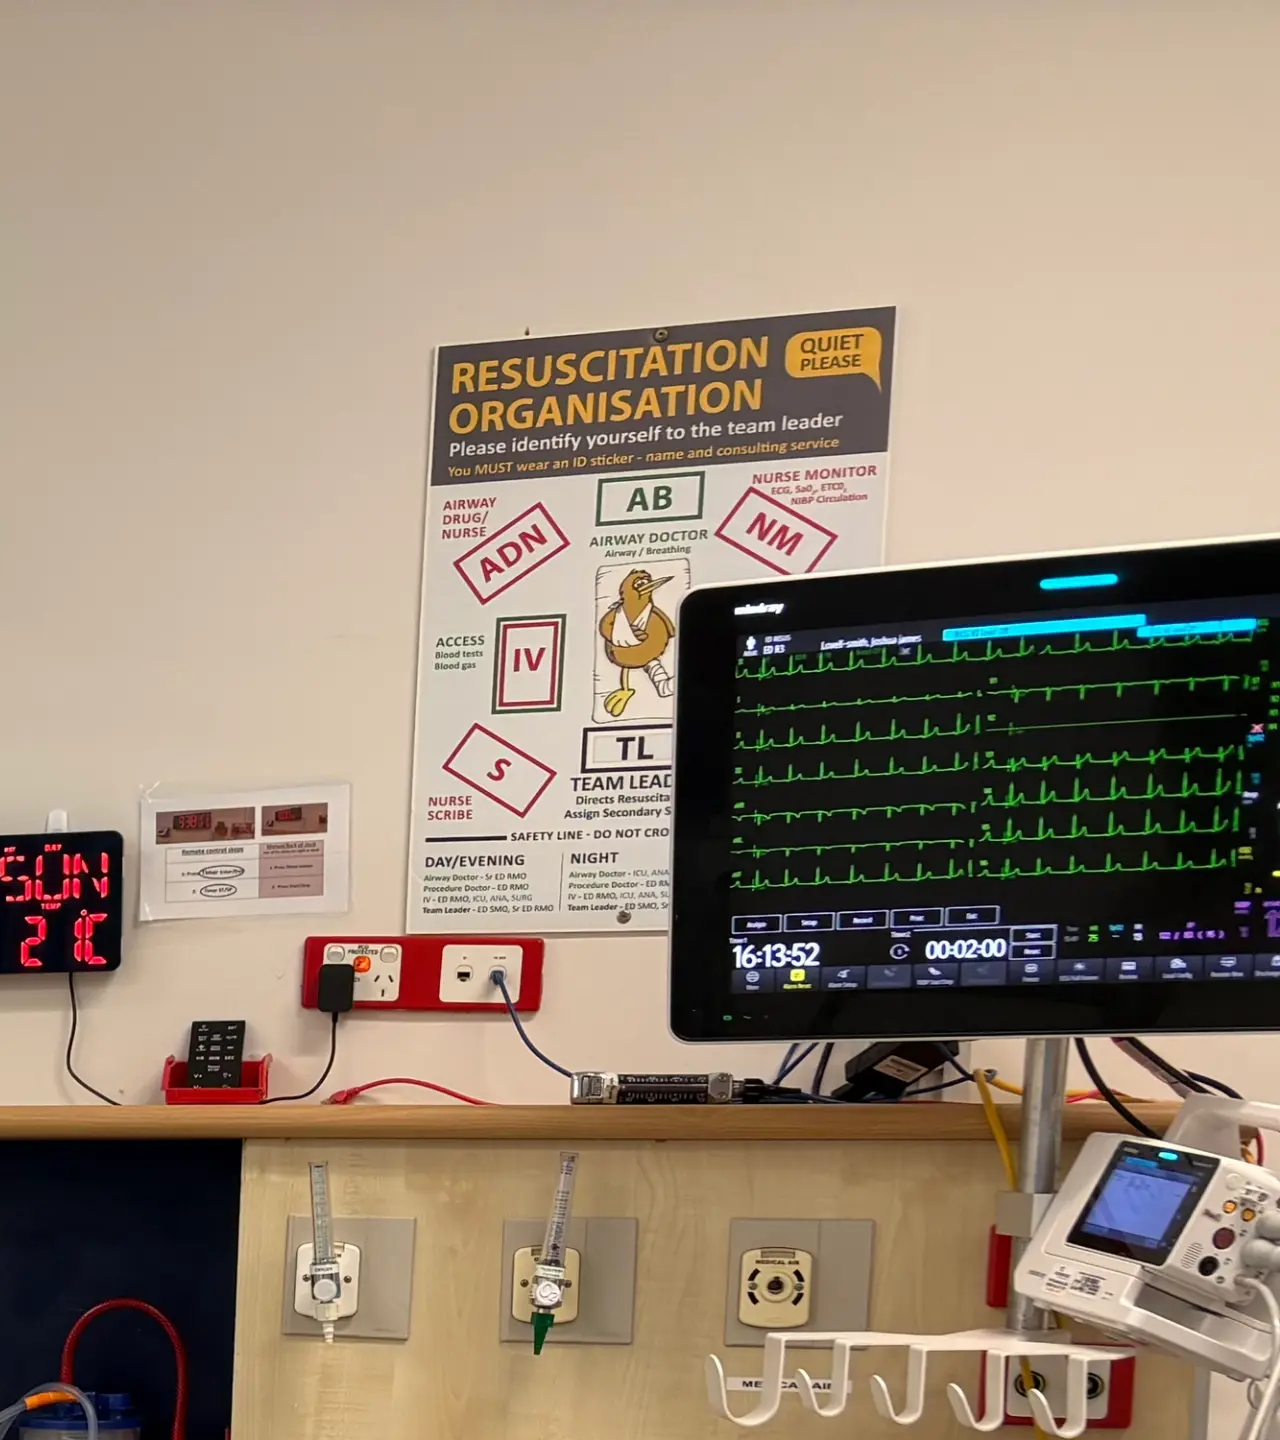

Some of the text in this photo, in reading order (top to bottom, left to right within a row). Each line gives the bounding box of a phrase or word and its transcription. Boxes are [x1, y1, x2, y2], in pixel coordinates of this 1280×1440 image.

[800, 333, 865, 355] QUIET
[451, 336, 769, 395] RESUSCITATION
[800, 354, 862, 372] PLEASE
[448, 378, 763, 435] ORGANISATION
[449, 412, 844, 458] Please identify yourself to the team leader
[448, 436, 840, 478] You MUST wear an ID sticker name and consulting service
[752, 465, 878, 484] NURSE MONITOR
[443, 497, 497, 512] AIRWAY
[625, 484, 674, 513] AB
[442, 511, 490, 526] DRUG/
[441, 525, 488, 540] NURSE
[589, 529, 709, 548] AIRWAY DOCTOR
[745, 511, 805, 557] NM
[477, 523, 549, 583] ADN
[604, 544, 692, 560] Airway Breathing
[435, 635, 486, 648] ACCESS
[435, 649, 484, 659] Blood tests
[513, 647, 547, 673] IV
[434, 661, 476, 672] Blood gas
[615, 736, 654, 761] TL
[486, 757, 512, 782] S
[570, 773, 672, 792] TEAM LEAD
[428, 795, 473, 806] NURSE
[575, 793, 671, 806] Directs Resuscita
[427, 809, 474, 821] SCRIBE
[564, 807, 663, 821] Assign Secondary
[510, 827, 670, 842] SAFETY LINE DO NOT CRO
[425, 854, 525, 869] DAY/EVENING
[570, 852, 620, 865] NIGHT
[423, 873, 451, 883] Airway
[452, 872, 479, 882] Doctor
[494, 872, 505, 881] ED
[507, 871, 527, 880] RMO
[568, 870, 597, 880] Airway
[598, 869, 627, 878] Doctor
[422, 882, 529, 893] Procedure Doctor ED RMO
[568, 880, 657, 890] Procedure Doctor ED
[437, 894, 449, 904] ED
[583, 892, 594, 901] ED
[422, 906, 442, 914] Team
[443, 905, 471, 914] Leader
[477, 905, 488, 914] ED
[489, 904, 510, 915] SMO,
[521, 904, 533, 913] ED
[533, 903, 554, 913] RMO
[567, 904, 587, 912] Team
[588, 903, 617, 912] Leader
[624, 902, 635, 911] ED
[636, 902, 658, 912] SMO,
[731, 942, 821, 969] 16:13:52
[925, 938, 1007, 960] 00:02:00
